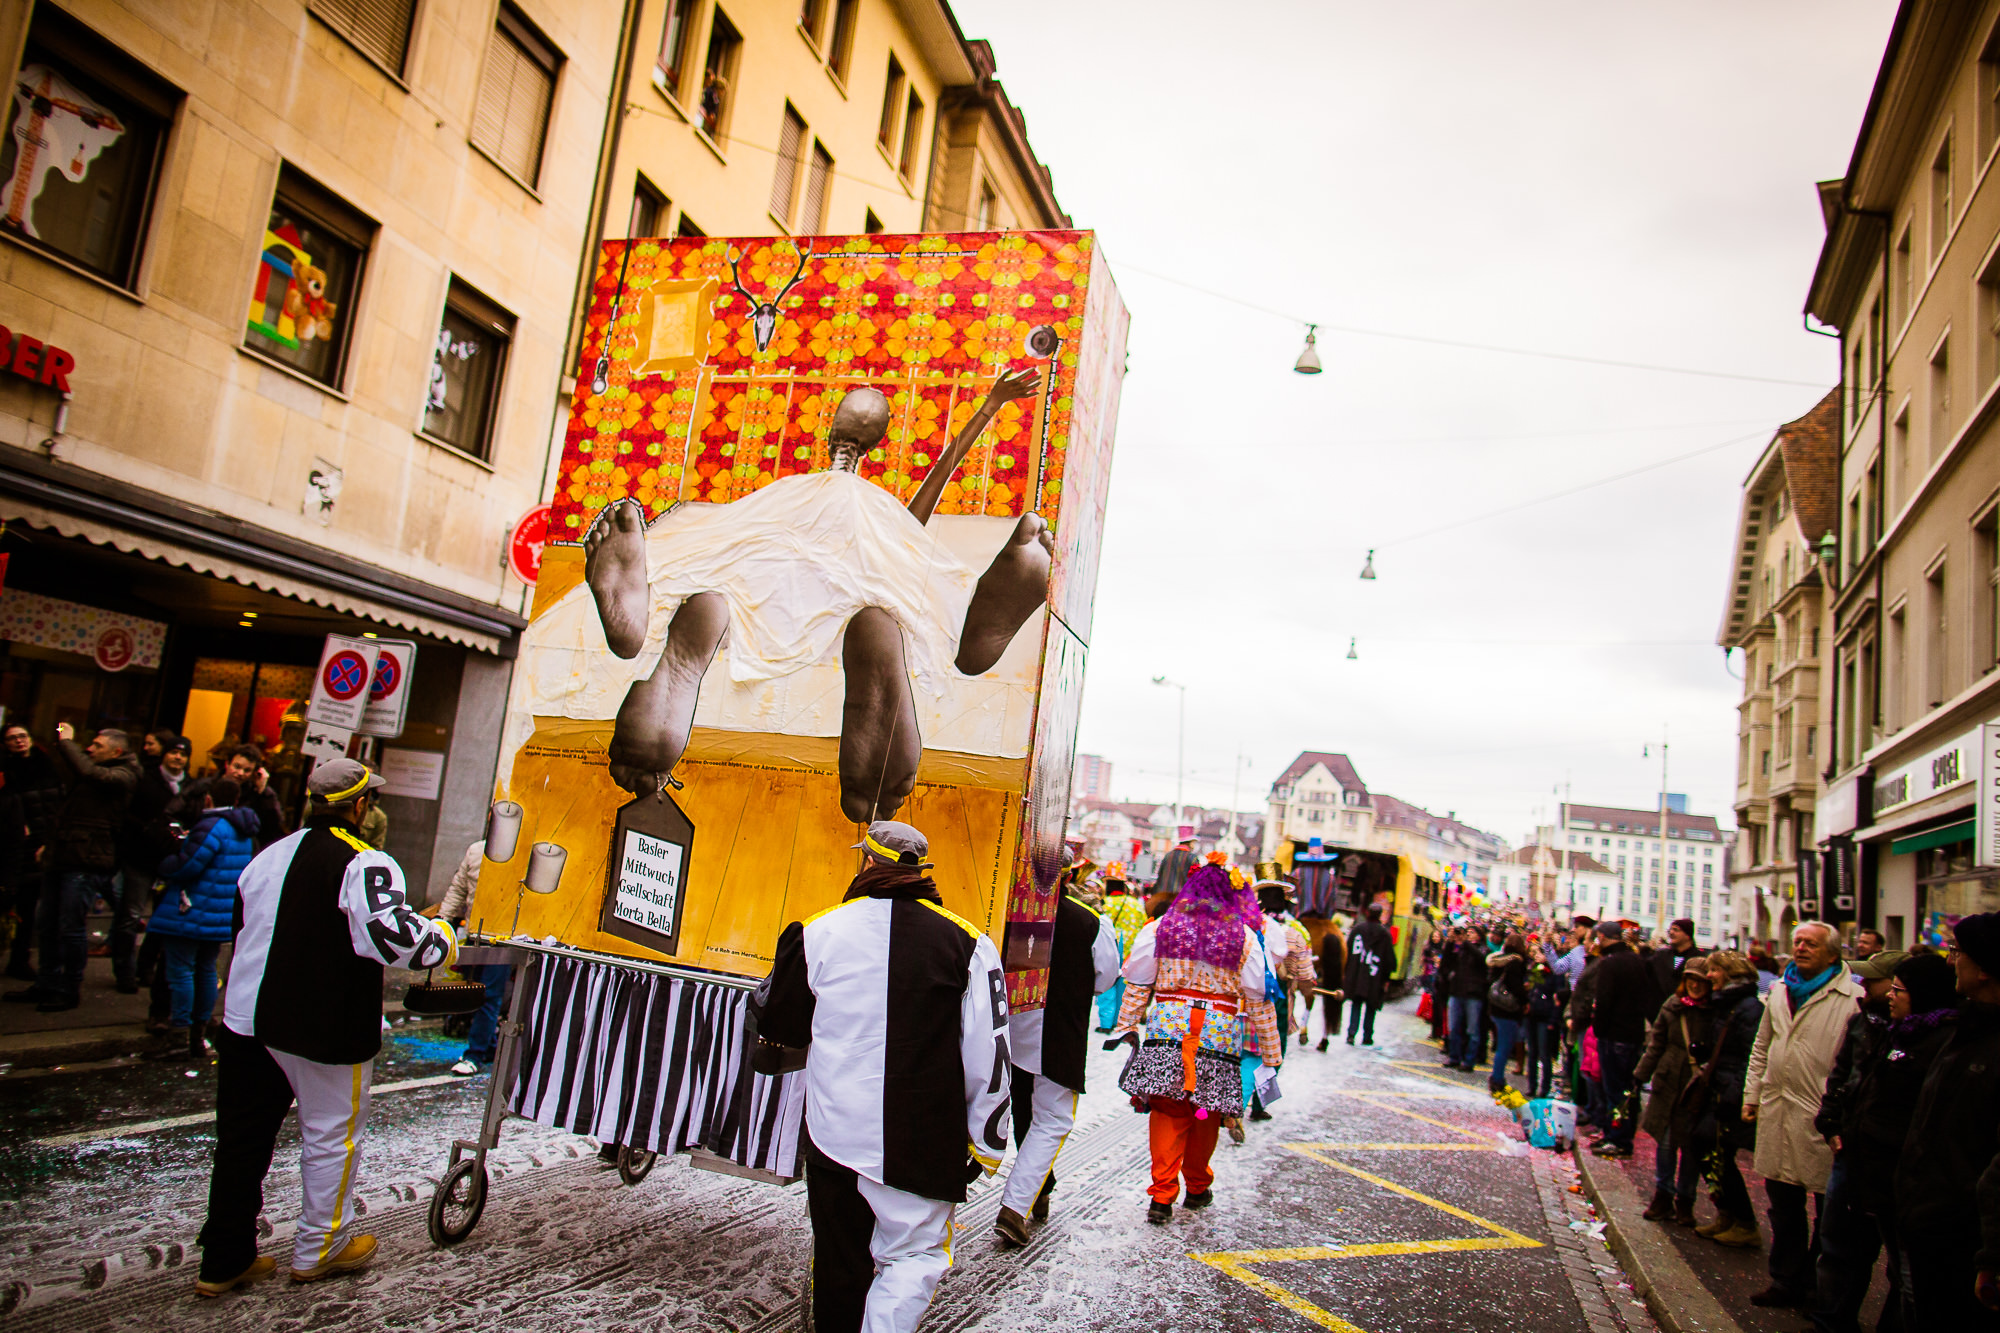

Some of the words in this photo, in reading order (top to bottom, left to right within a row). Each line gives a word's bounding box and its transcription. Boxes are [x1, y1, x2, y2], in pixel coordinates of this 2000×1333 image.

[638, 837, 669, 860] Basler
[625, 857, 674, 887] Mittwuch
[618, 878, 674, 909] Gsellschaft
[615, 900, 644, 924] Morta
[647, 910, 671, 933] Bella
